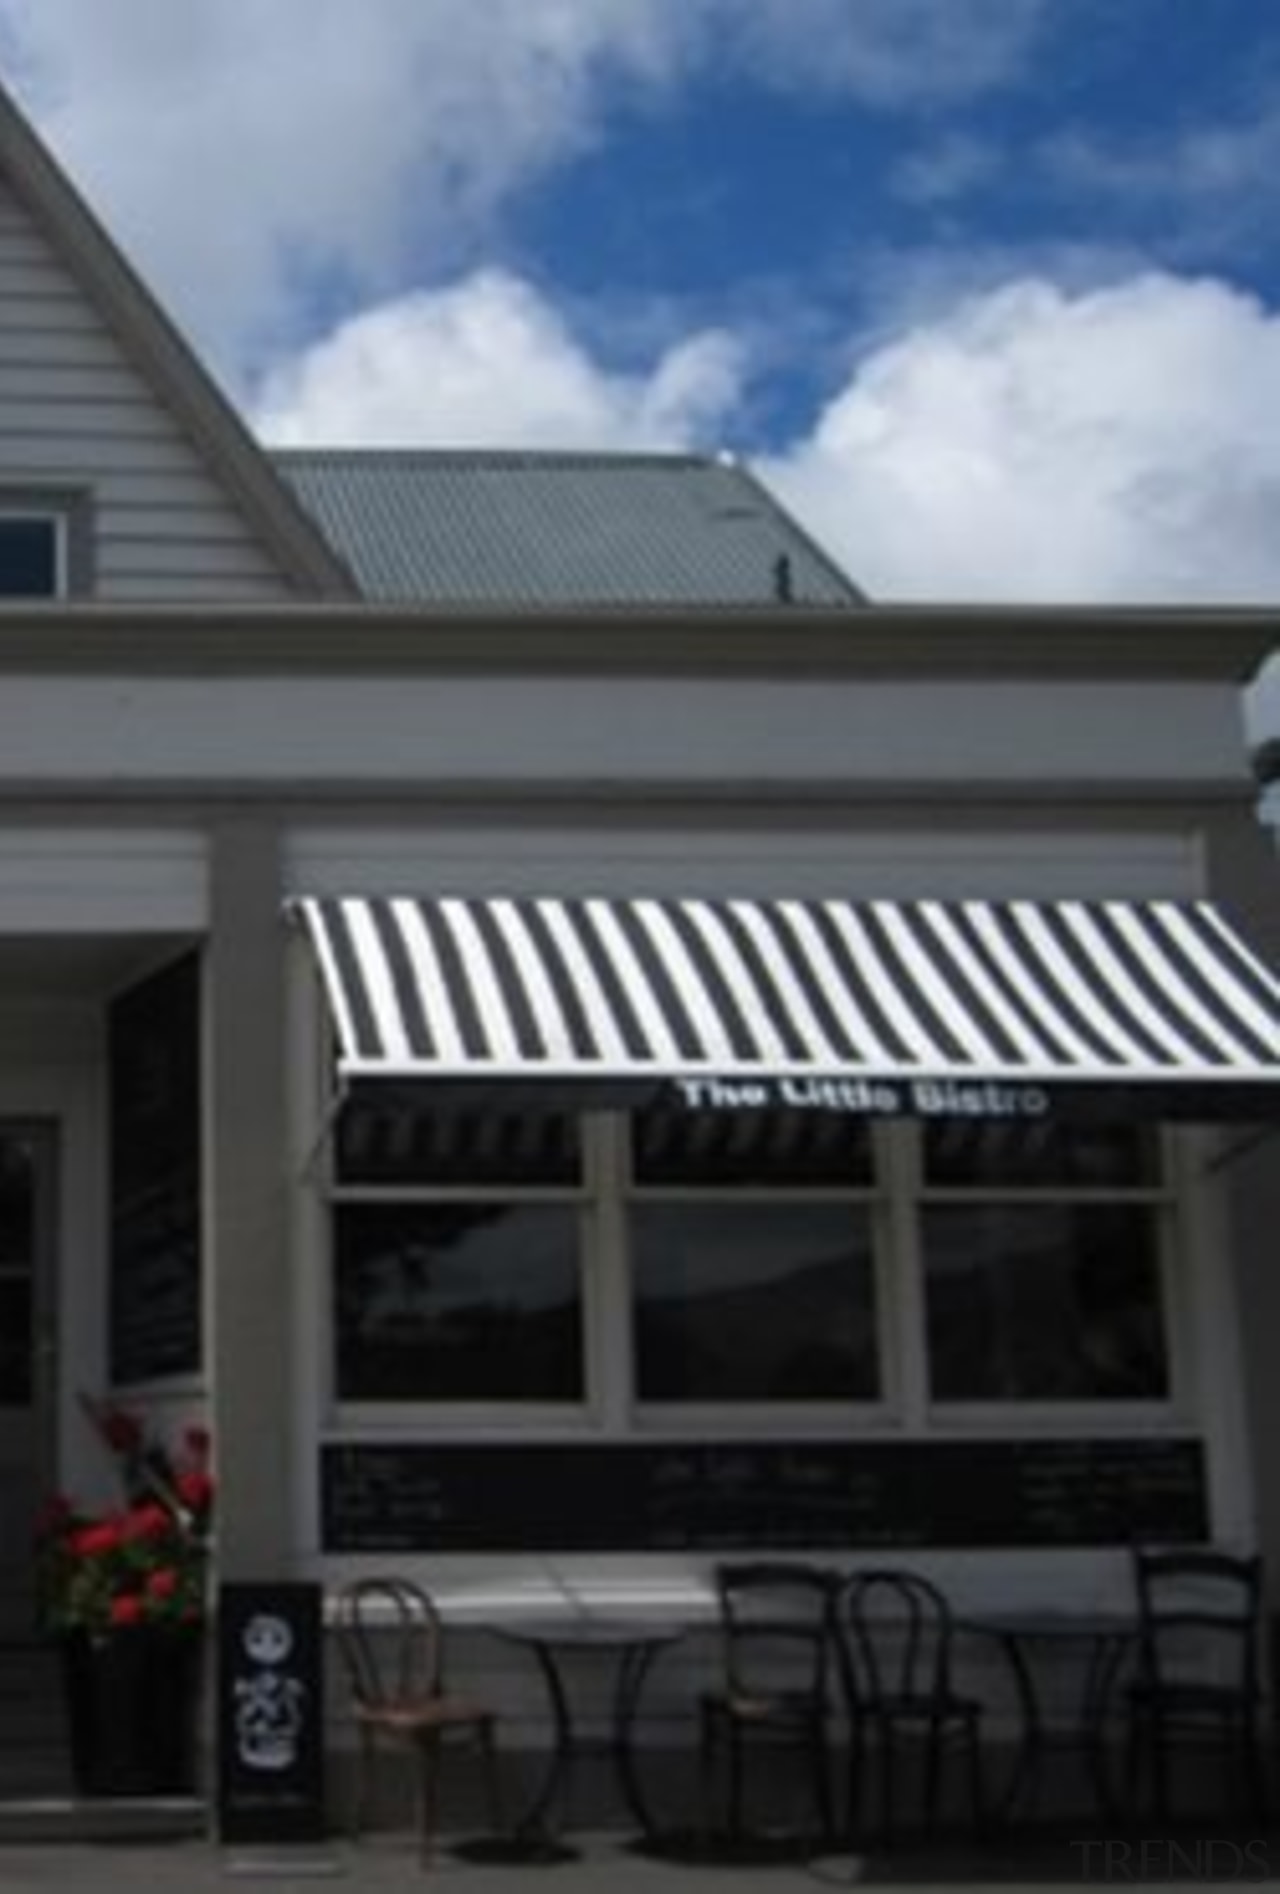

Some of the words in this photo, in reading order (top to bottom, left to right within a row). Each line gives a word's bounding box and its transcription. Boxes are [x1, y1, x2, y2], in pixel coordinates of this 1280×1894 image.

[679, 1079, 767, 1108] The
[780, 1078, 899, 1113] Little
[912, 1081, 1050, 1116] Bistro
